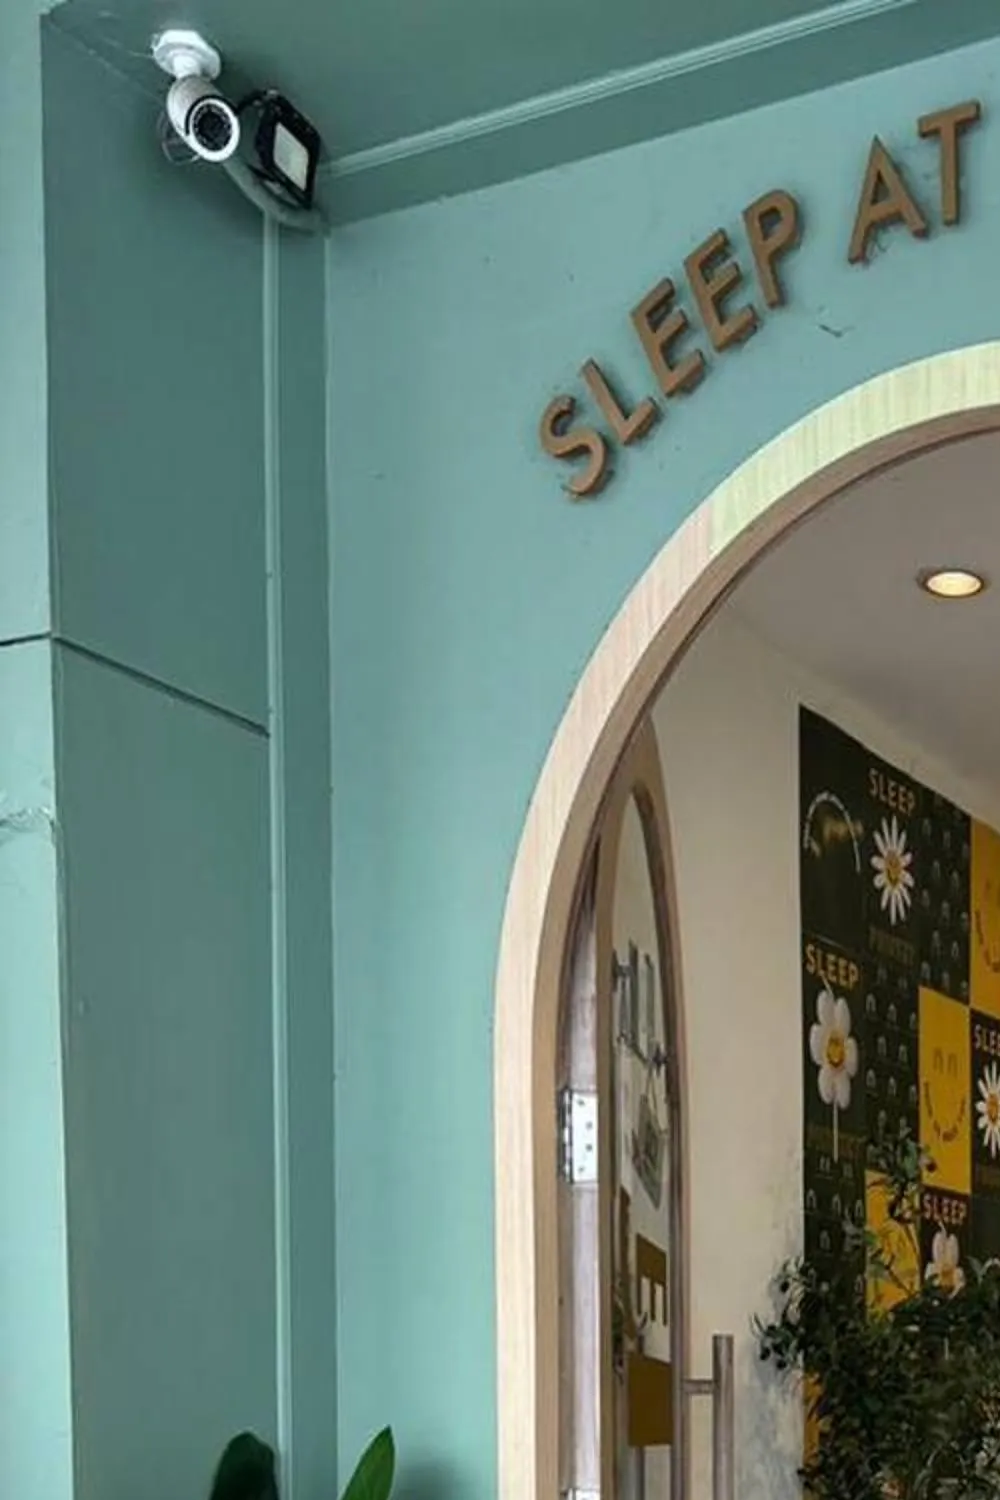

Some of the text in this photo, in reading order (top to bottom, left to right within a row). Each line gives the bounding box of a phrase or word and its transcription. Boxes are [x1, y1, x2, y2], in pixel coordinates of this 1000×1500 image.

[538, 188, 804, 499] SLEEP
[846, 100, 981, 264] AT
[869, 767, 916, 816] SLEEP
[804, 943, 860, 989] SLEEP
[923, 1193, 967, 1224] SLEEP
